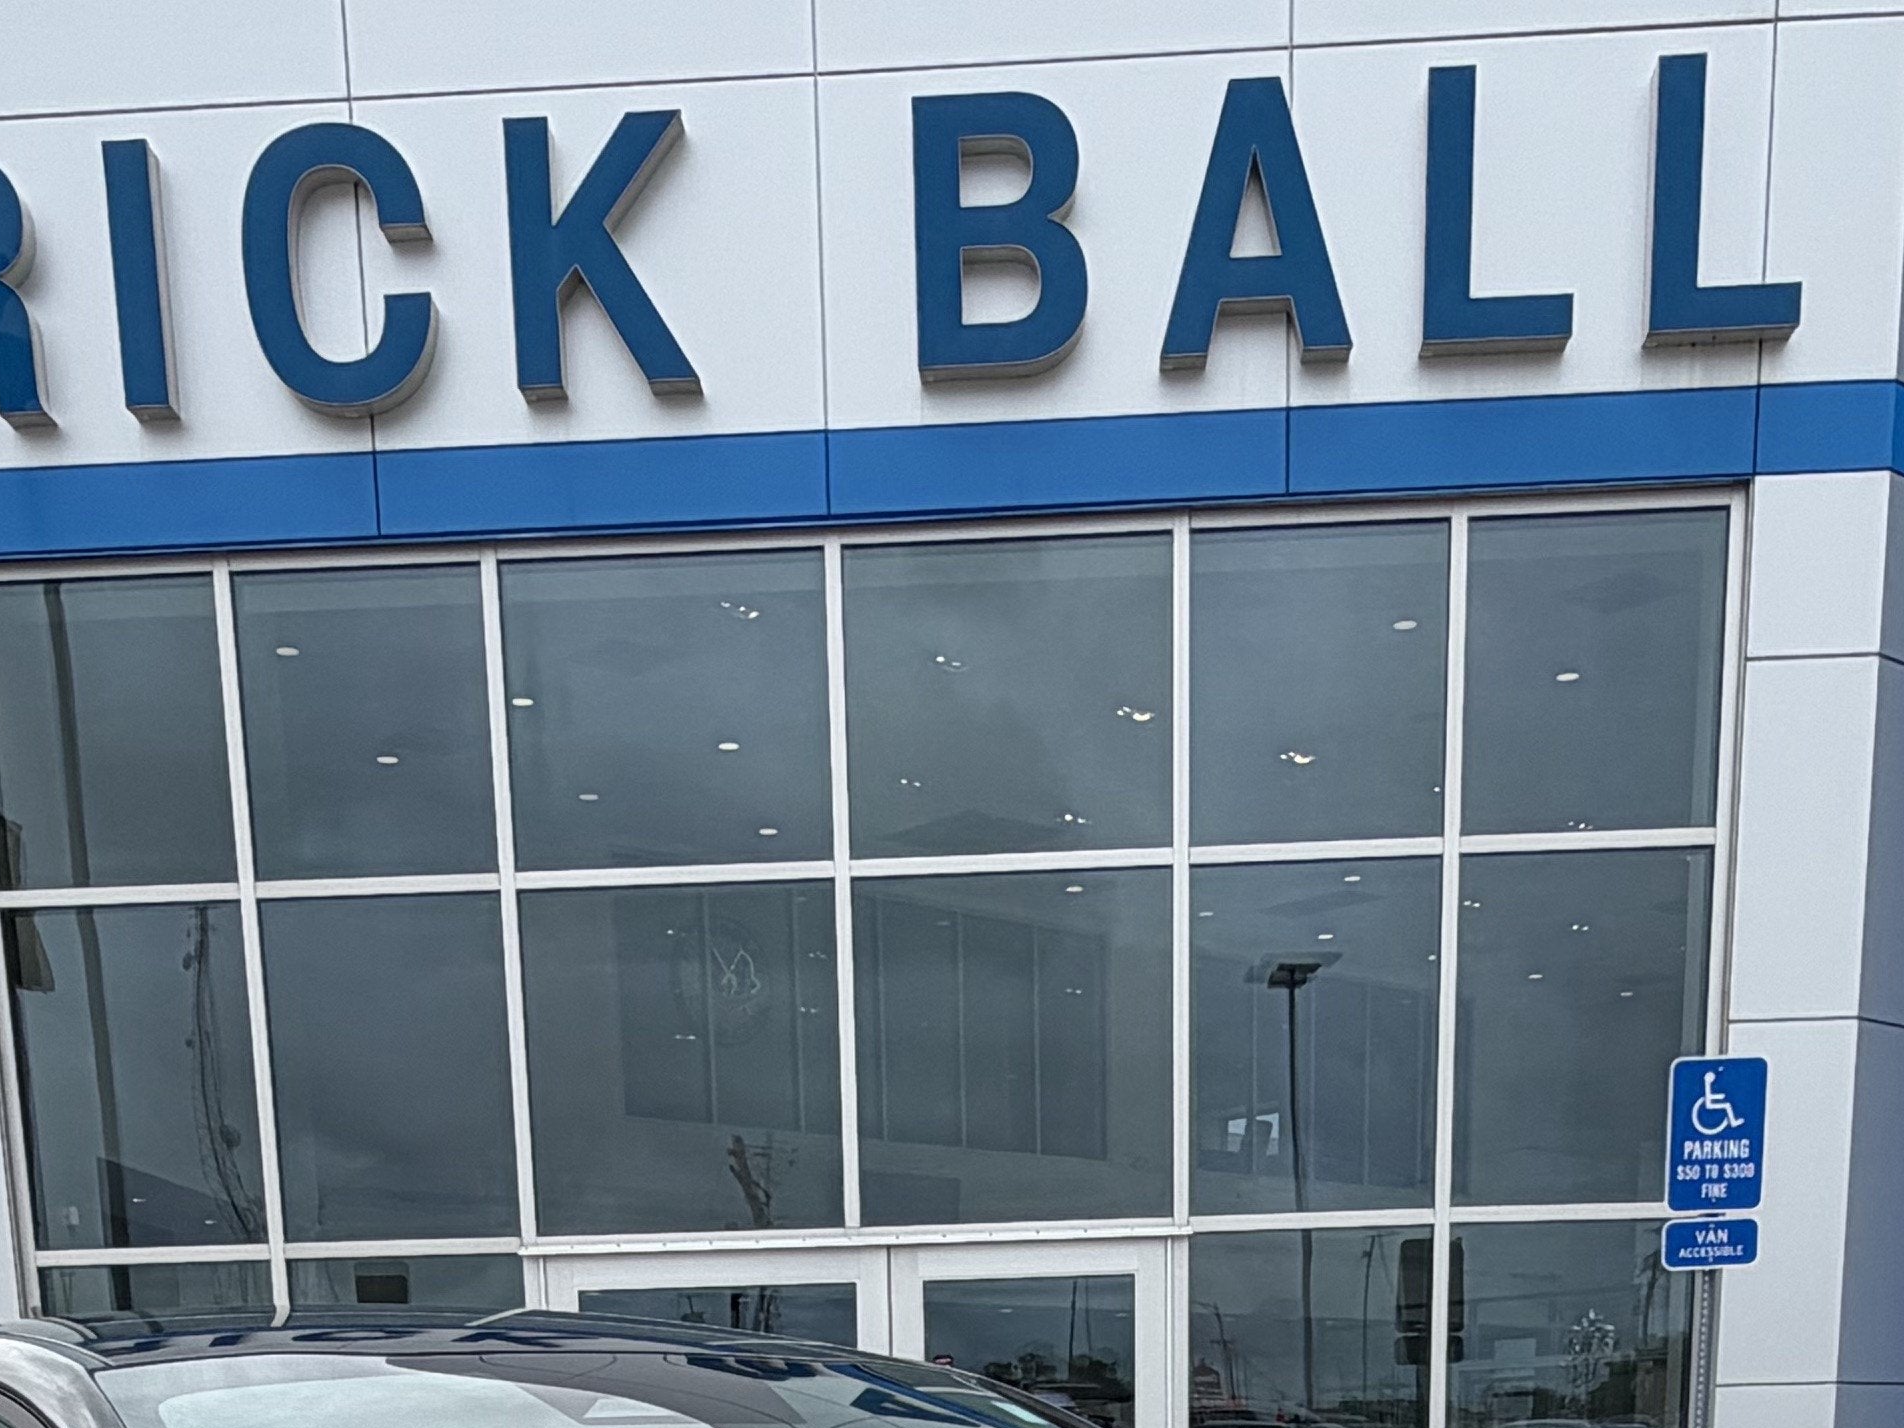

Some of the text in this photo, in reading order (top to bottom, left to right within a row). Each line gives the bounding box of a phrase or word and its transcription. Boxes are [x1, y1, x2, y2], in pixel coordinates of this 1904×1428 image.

[910, 52, 1803, 385] BALL
[1683, 1139, 1750, 1160] PARKING
[1677, 1163, 1755, 1180] $50 TO $300
[1701, 1183, 1728, 1198] FINE
[1695, 1229, 1729, 1244] VAN
[1678, 1245, 1744, 1259] ACCESSIBLE
